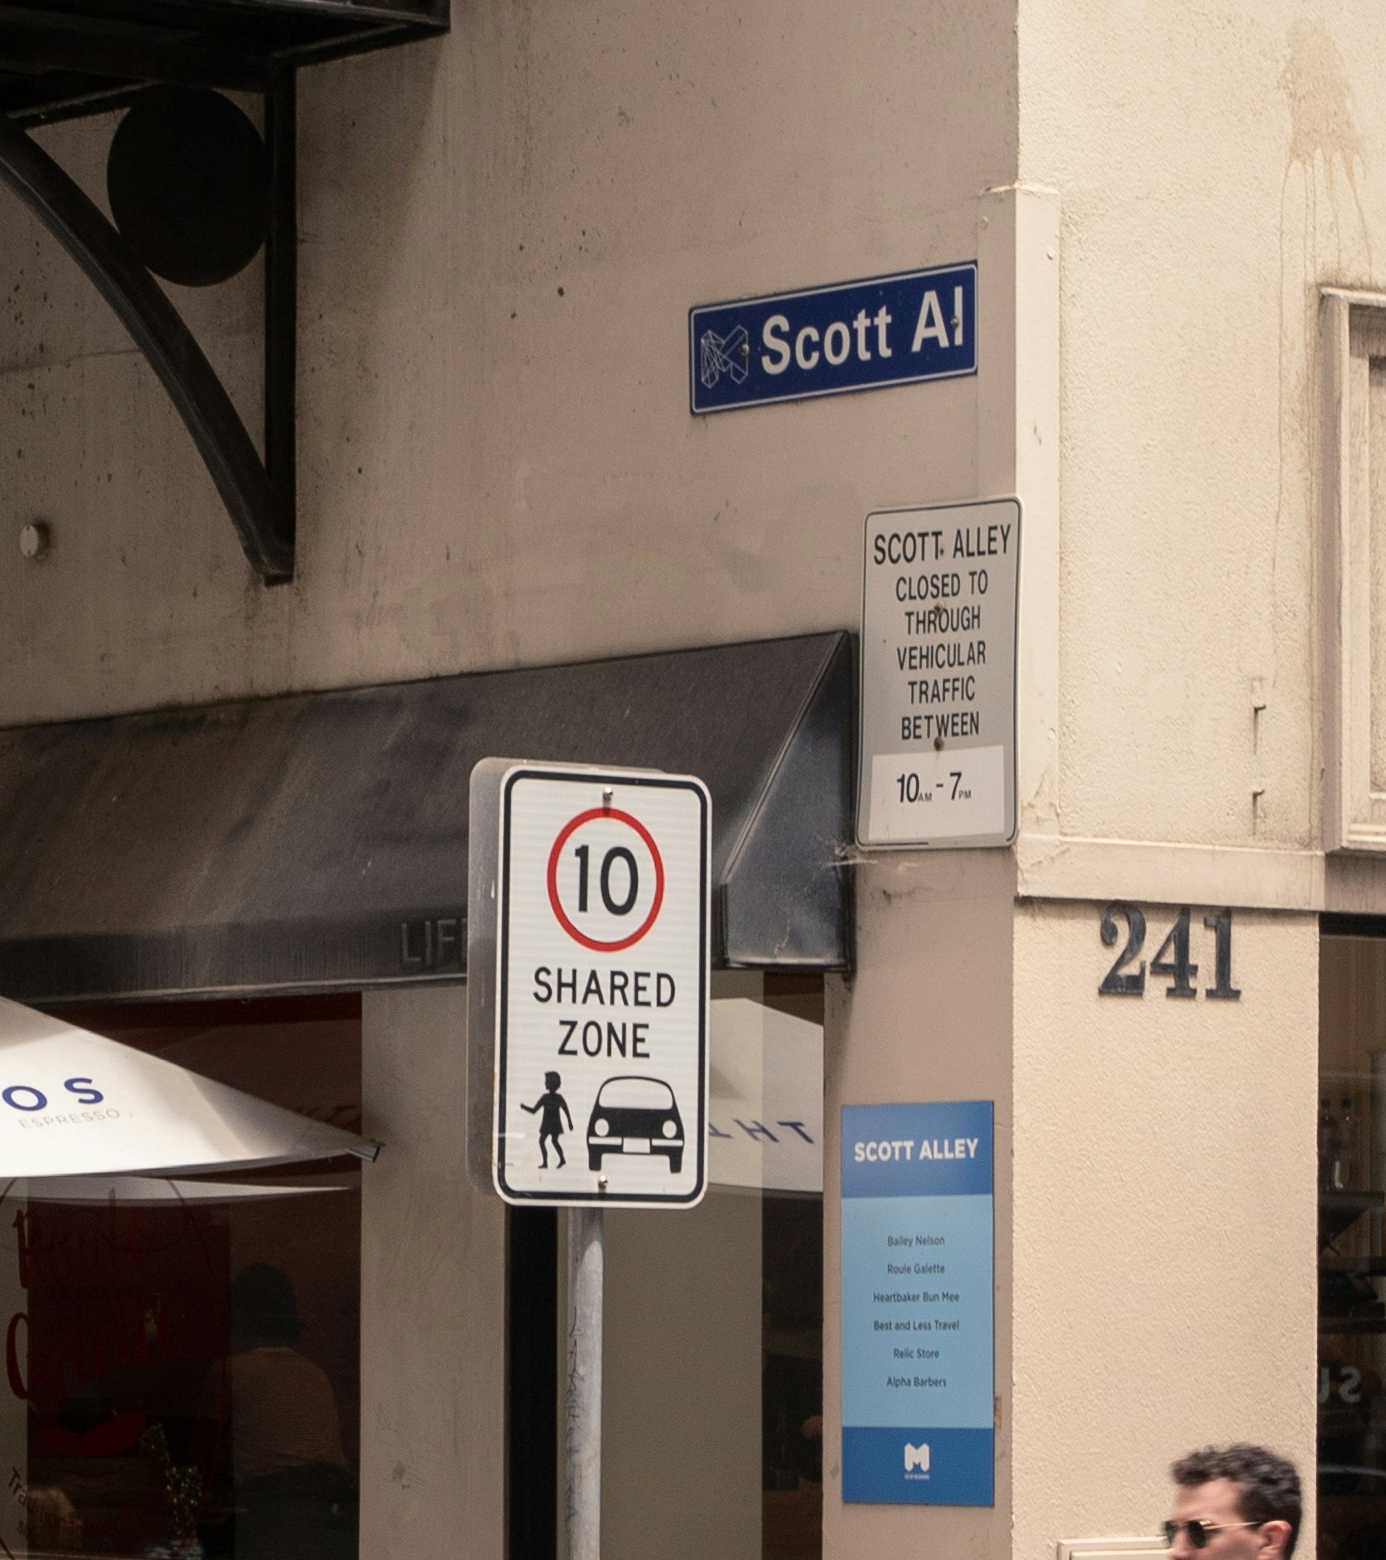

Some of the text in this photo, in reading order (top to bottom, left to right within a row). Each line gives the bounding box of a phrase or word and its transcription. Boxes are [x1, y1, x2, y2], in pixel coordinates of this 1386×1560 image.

[761, 285, 963, 376] Scott Al
[874, 524, 1011, 565] SCOTT ALLEY
[896, 569, 988, 602] CLOSED TO
[905, 605, 981, 635] THROUGH
[897, 641, 986, 671] VEHICULAR
[908, 675, 975, 705] TRAFFIC
[901, 711, 980, 741] BETWEEN
[574, 844, 639, 916] 10
[1099, 907, 1242, 1001] 241
[533, 966, 676, 1008] SHARED
[558, 1020, 651, 1060] ZONE
[19, 1109, 120, 1129] ESPRESSO
[854, 1138, 979, 1162] SCOTT ALLEY
[887, 1235, 945, 1248] Bailey Nelson
[887, 1263, 945, 1275] Roule Galette
[873, 1292, 960, 1303] Heartbaker Bun Mee
[873, 1320, 960, 1331] Best and Less Travel
[893, 1348, 939, 1359] Relic Store
[886, 1377, 946, 1388] Alpha Barbers
